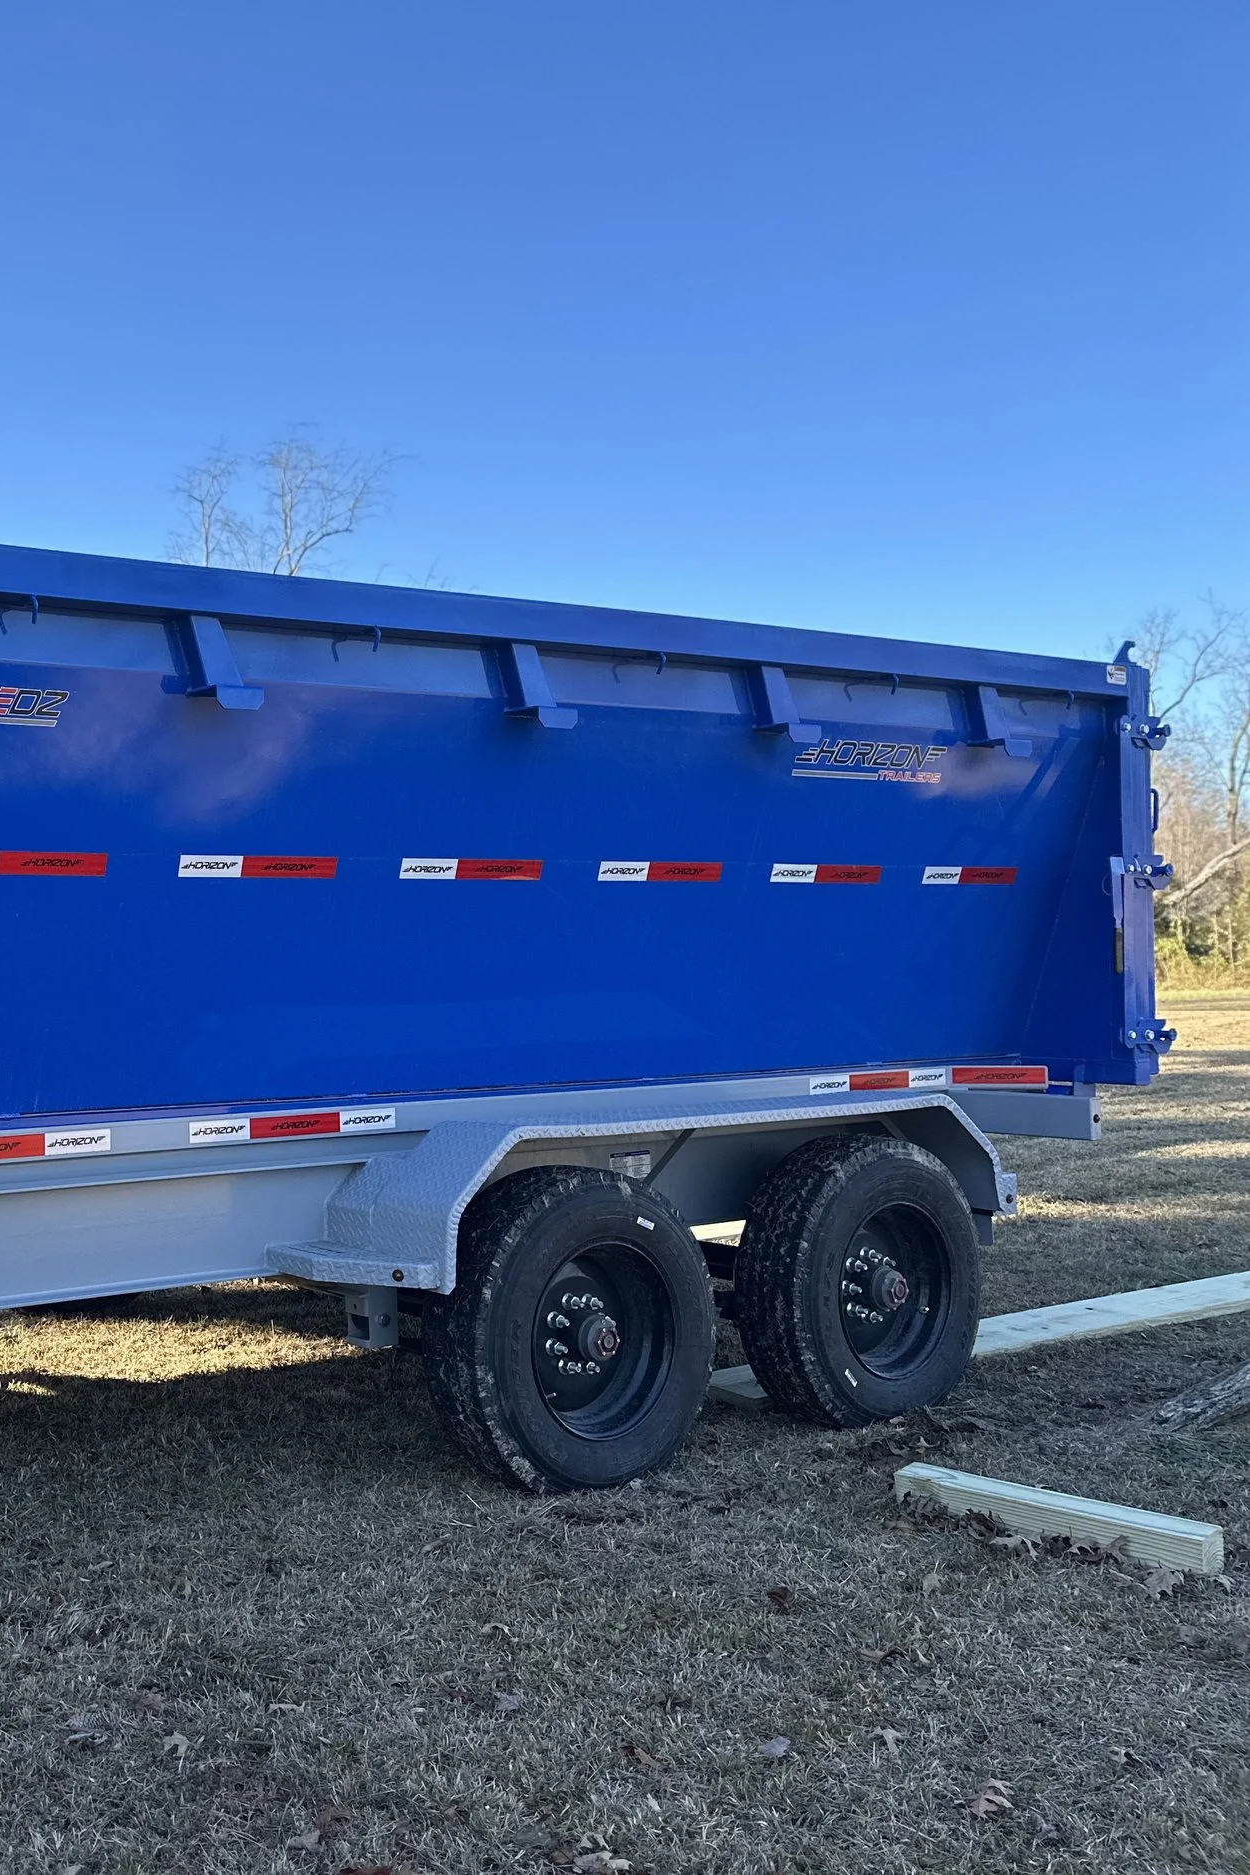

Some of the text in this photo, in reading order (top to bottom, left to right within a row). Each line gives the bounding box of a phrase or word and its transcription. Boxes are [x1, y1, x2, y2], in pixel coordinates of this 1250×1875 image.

[814, 739, 930, 769] HORIZON
[878, 769, 942, 784] TRAILERS
[28, 857, 76, 868] HORIZON
[188, 861, 232, 870] HORIZON
[267, 863, 310, 872] HORIZON
[409, 865, 448, 874] HORIZON
[606, 867, 640, 875] HORIZON
[349, 1114, 388, 1125] HORIZON
[198, 1126, 240, 1136] HORIZON
[275, 1120, 317, 1131] HORIZON
[53, 1135, 100, 1148] HORIZON
